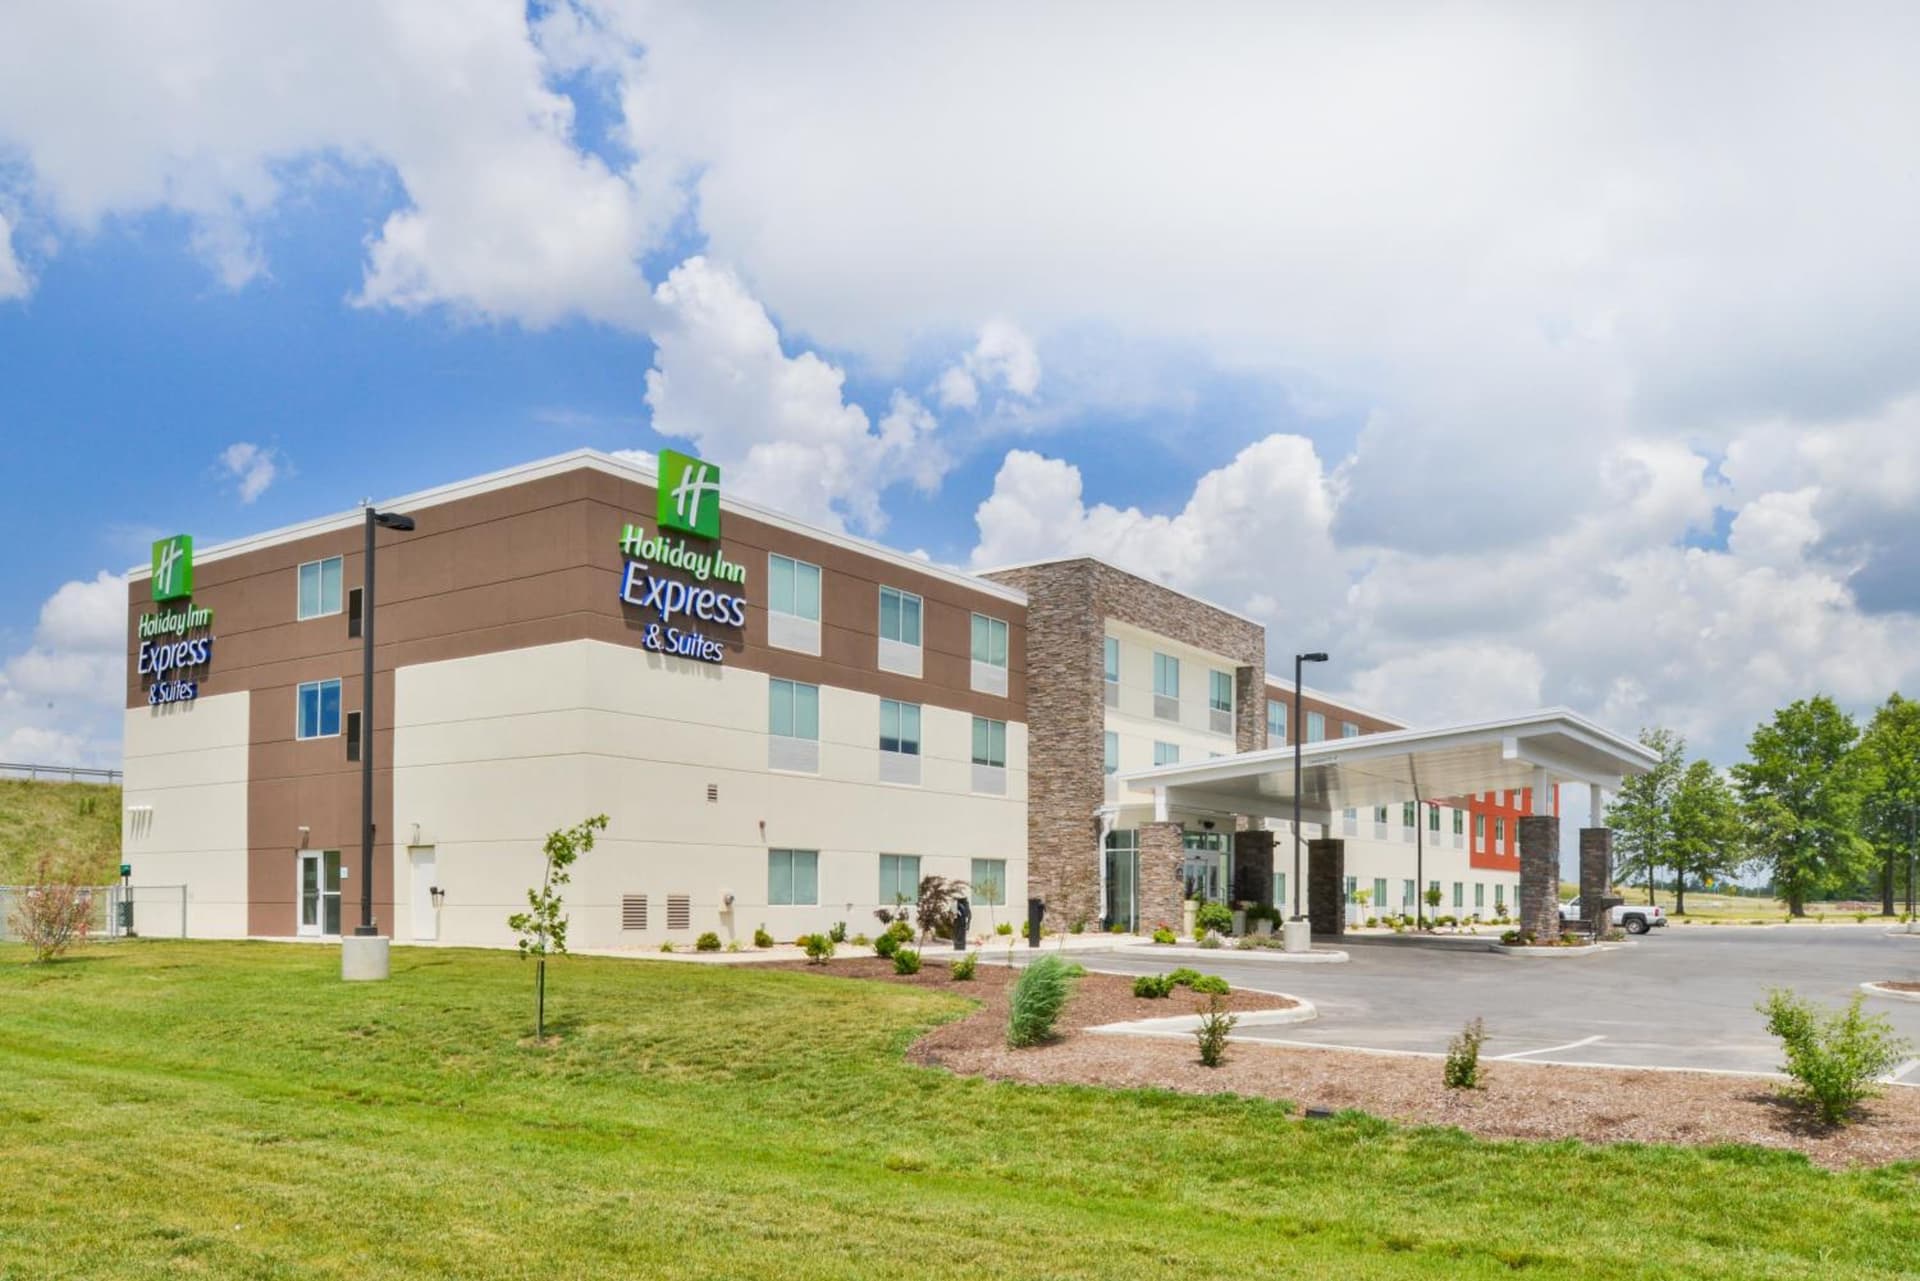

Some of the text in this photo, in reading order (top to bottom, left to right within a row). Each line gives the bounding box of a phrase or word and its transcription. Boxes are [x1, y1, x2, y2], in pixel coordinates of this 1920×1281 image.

[620, 524, 746, 584] Holiday Inn
[622, 560, 747, 627] Express
[138, 603, 209, 639] Holiday Inn
[138, 637, 209, 681] Express
[645, 623, 724, 662] & Suites
[148, 681, 194, 705] & Suites
